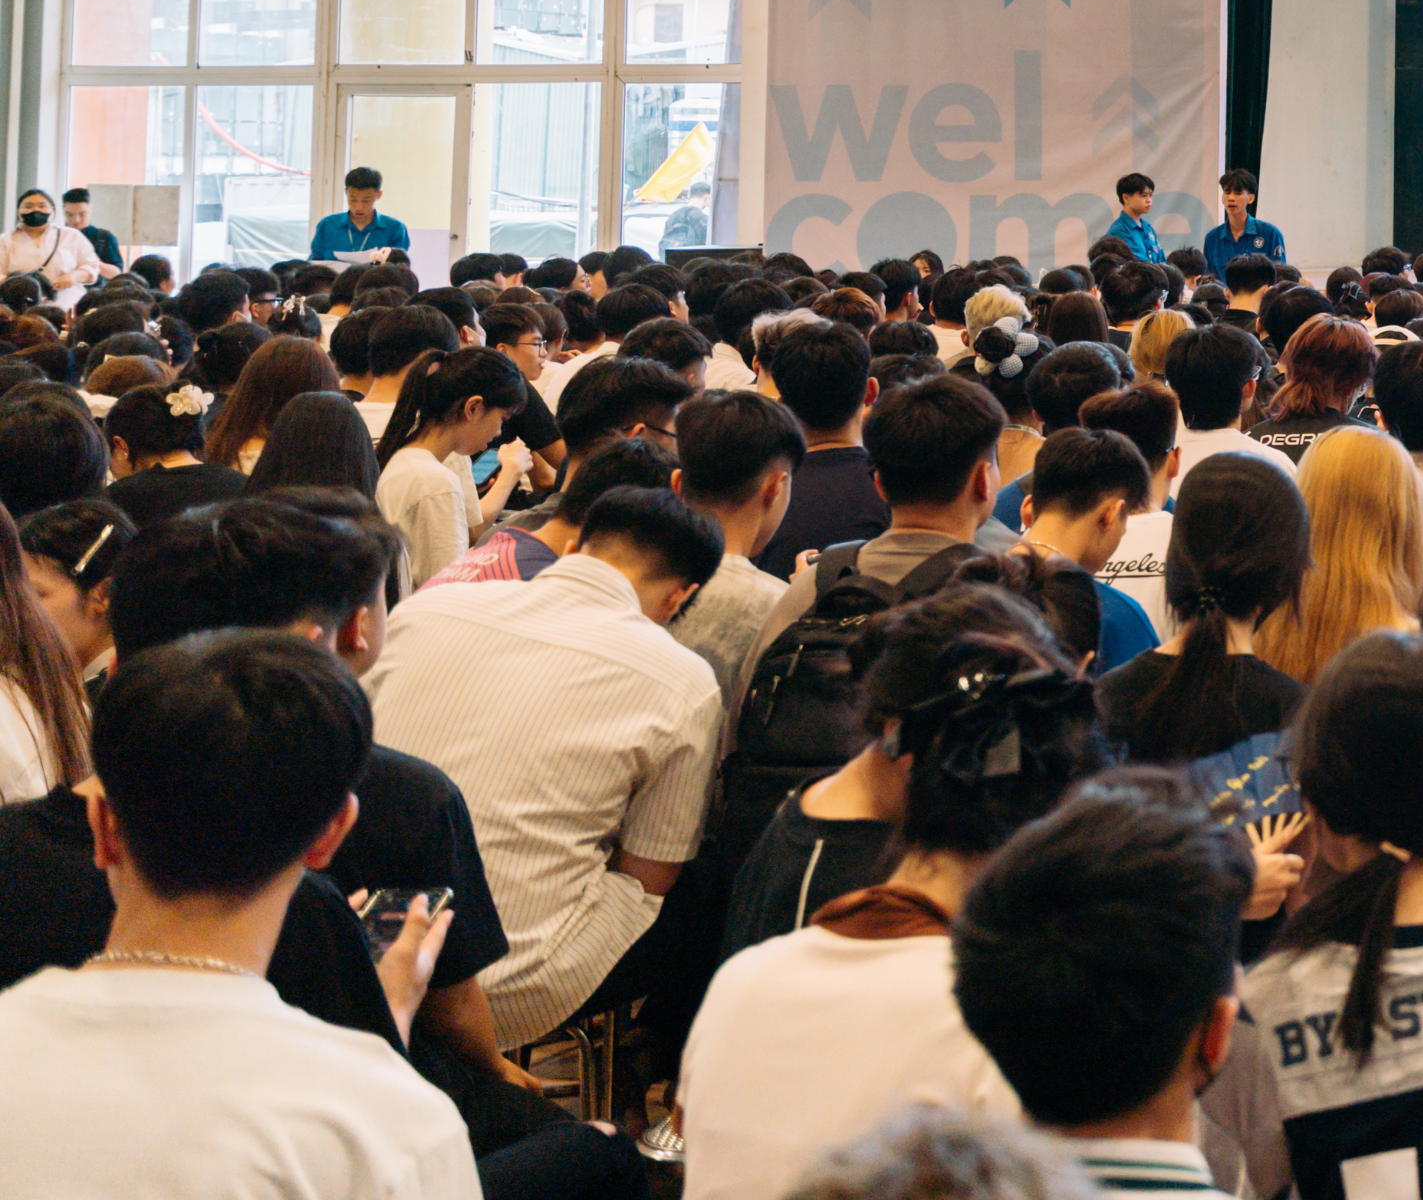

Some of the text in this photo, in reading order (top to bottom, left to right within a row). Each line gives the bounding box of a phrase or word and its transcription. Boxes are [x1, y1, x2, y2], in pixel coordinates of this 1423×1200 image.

[769, 50, 1043, 183] wel
[1260, 432, 1324, 447] DEGR
[1099, 552, 1166, 585] ngeles
